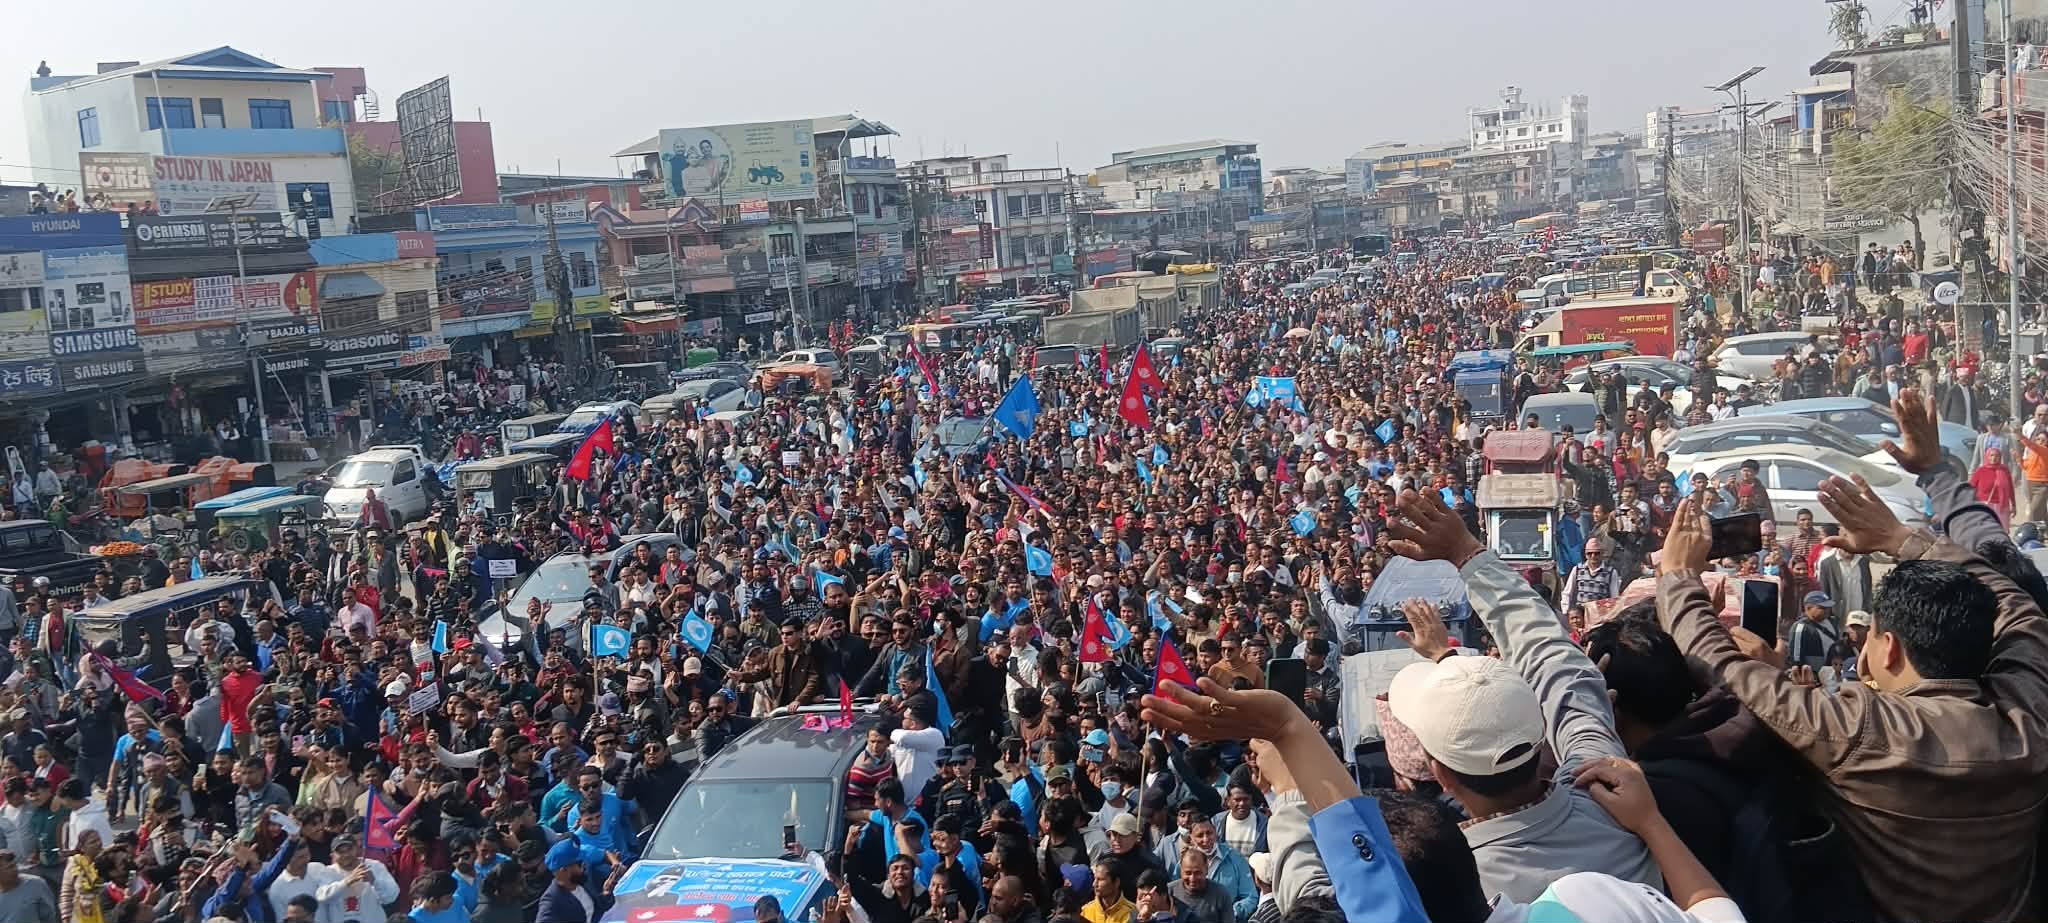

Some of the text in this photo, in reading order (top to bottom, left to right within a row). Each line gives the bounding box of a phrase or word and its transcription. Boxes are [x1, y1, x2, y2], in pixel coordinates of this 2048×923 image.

[84, 165, 151, 189] KOREA
[154, 157, 273, 183] STUDY IN JAPAN
[31, 218, 81, 233] HYUNDAI
[152, 223, 206, 239] CRIMSON
[151, 282, 193, 298] STUDY
[270, 325, 306, 338] BAAZAR
[53, 329, 138, 354] SAMSUNG
[73, 359, 134, 380] SAMSUNG
[265, 358, 310, 374] SAMSUNG
